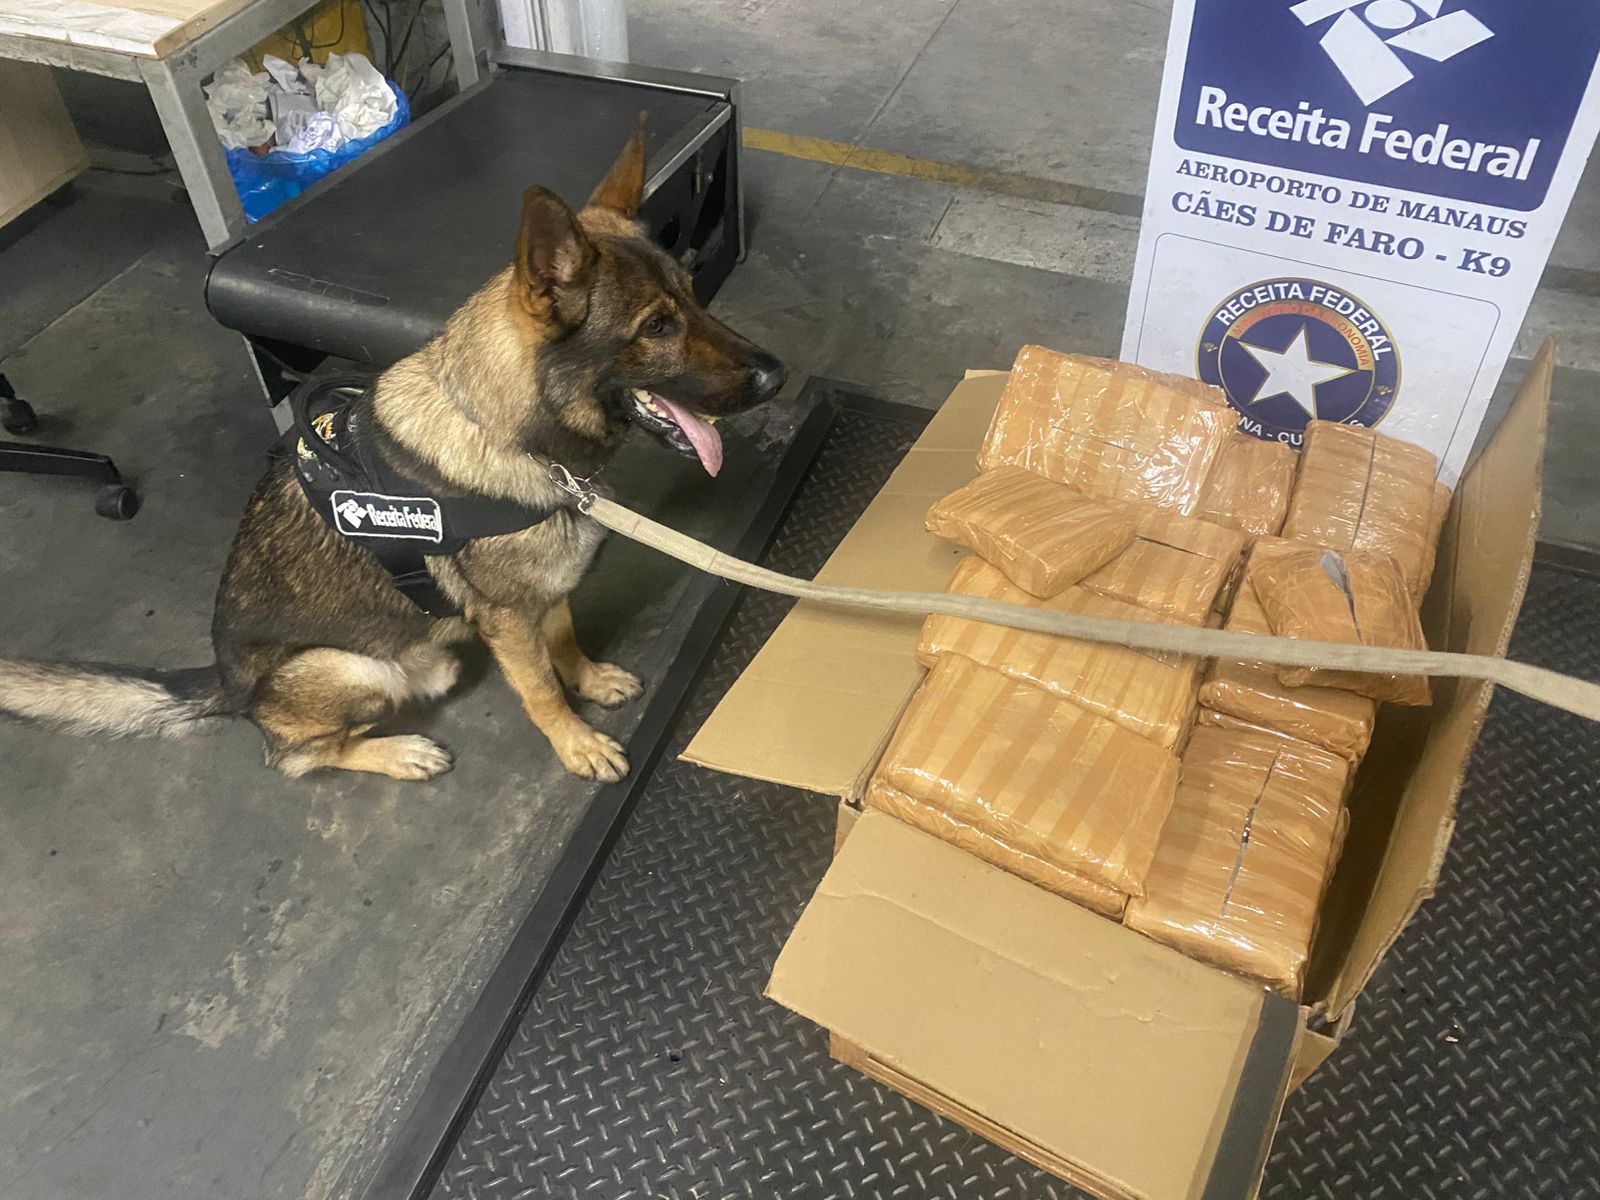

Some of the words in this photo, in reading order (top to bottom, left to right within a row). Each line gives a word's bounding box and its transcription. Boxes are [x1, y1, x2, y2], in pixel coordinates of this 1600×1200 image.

[1195, 85, 1351, 150] Receita
[1358, 112, 1541, 181] Federal
[1171, 189, 1257, 227] CÃES
[1265, 210, 1316, 239] DE
[1323, 222, 1425, 261] FARO
[1456, 248, 1513, 279] K9
[1175, 158, 1342, 205] AEROPORTO
[1347, 190, 1391, 213] DE
[1396, 200, 1528, 239] MANAUS
[1215, 282, 1305, 328] RECEITA
[1309, 285, 1392, 362] FEDERAL
[365, 503, 406, 529] Receita
[402, 505, 439, 532] Federal
